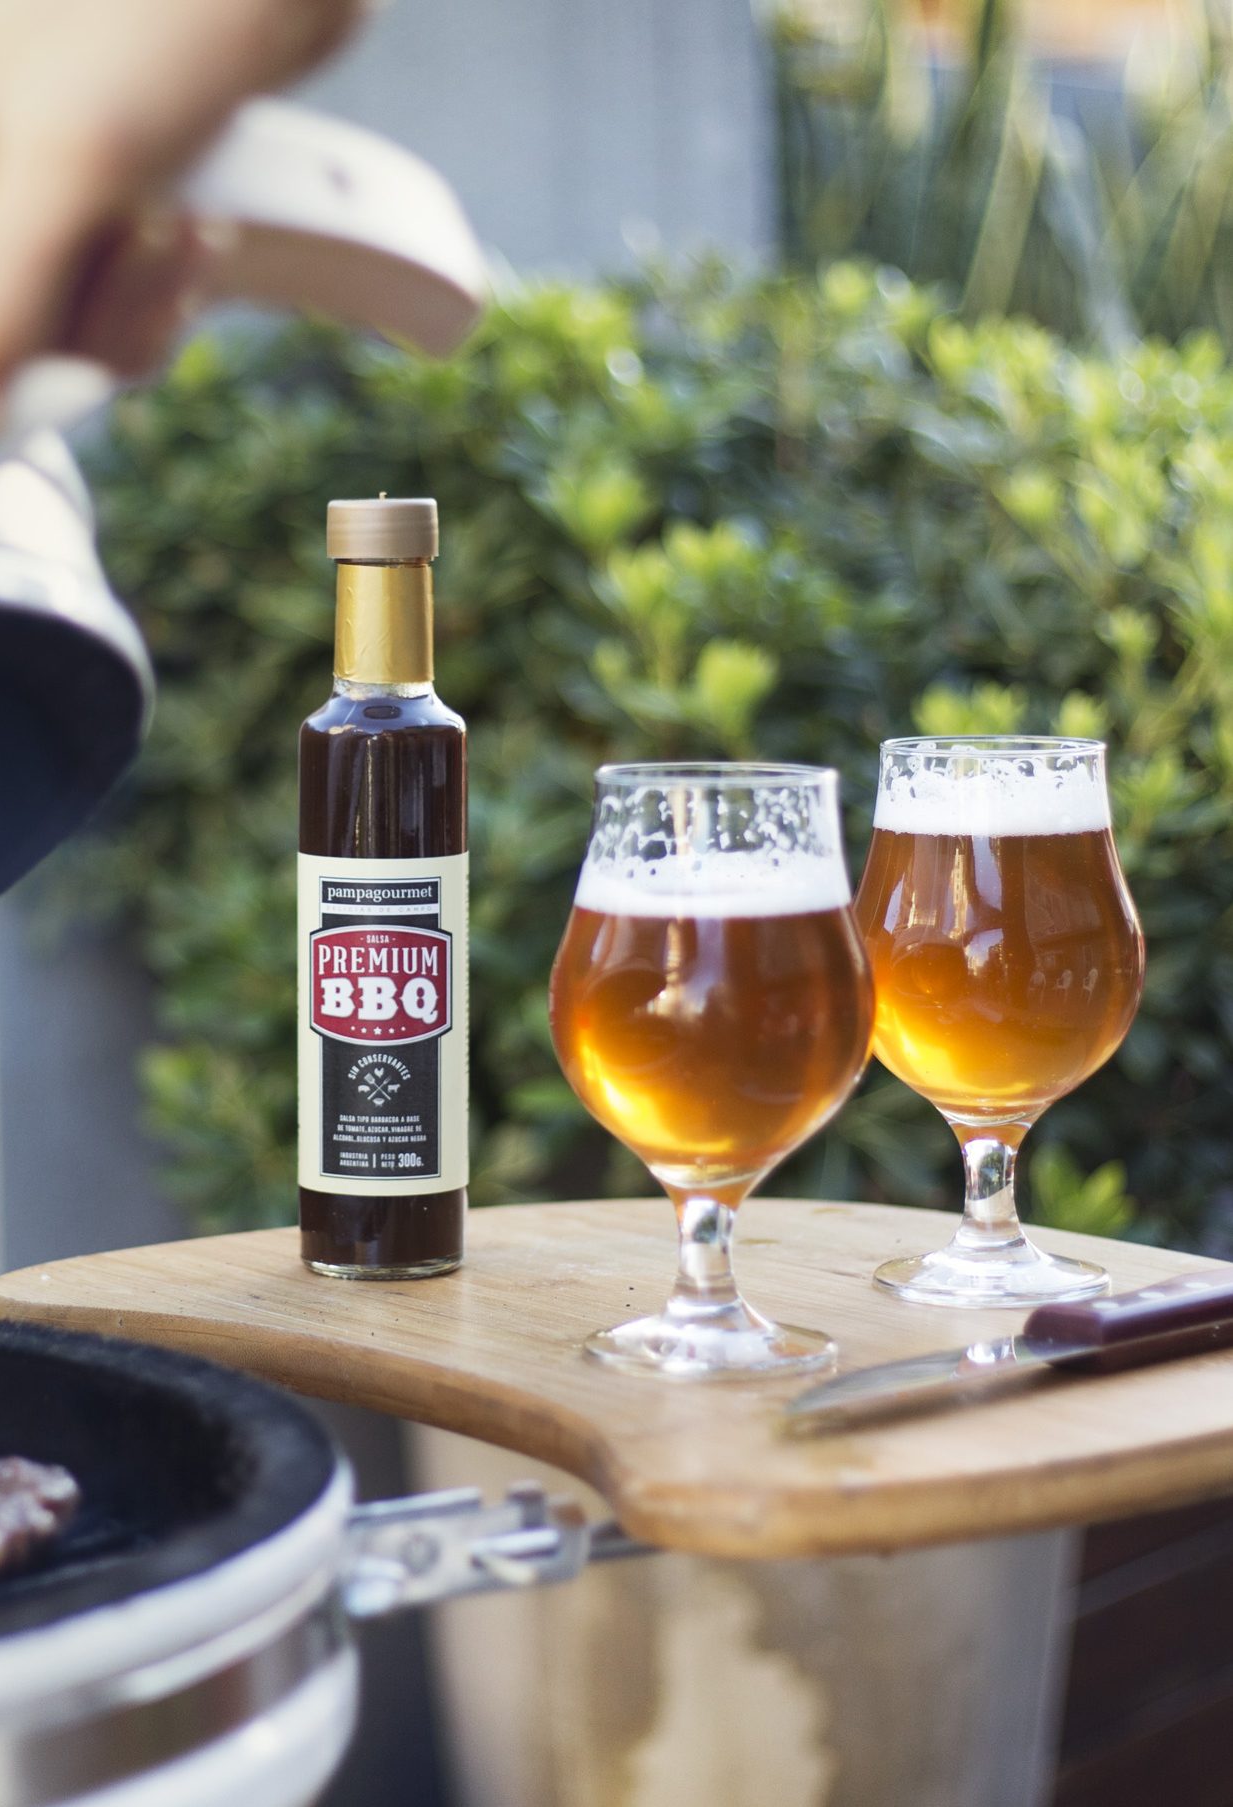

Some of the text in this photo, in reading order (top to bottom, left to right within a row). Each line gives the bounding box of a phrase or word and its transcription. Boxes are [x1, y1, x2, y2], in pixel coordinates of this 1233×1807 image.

[327, 885, 432, 903] pampagourmet
[366, 934, 390, 944] SALSA
[318, 944, 439, 976] PREMIUM
[320, 977, 439, 1025] BBQ
[347, 1053, 412, 1080] SIN CONSERVANTES
